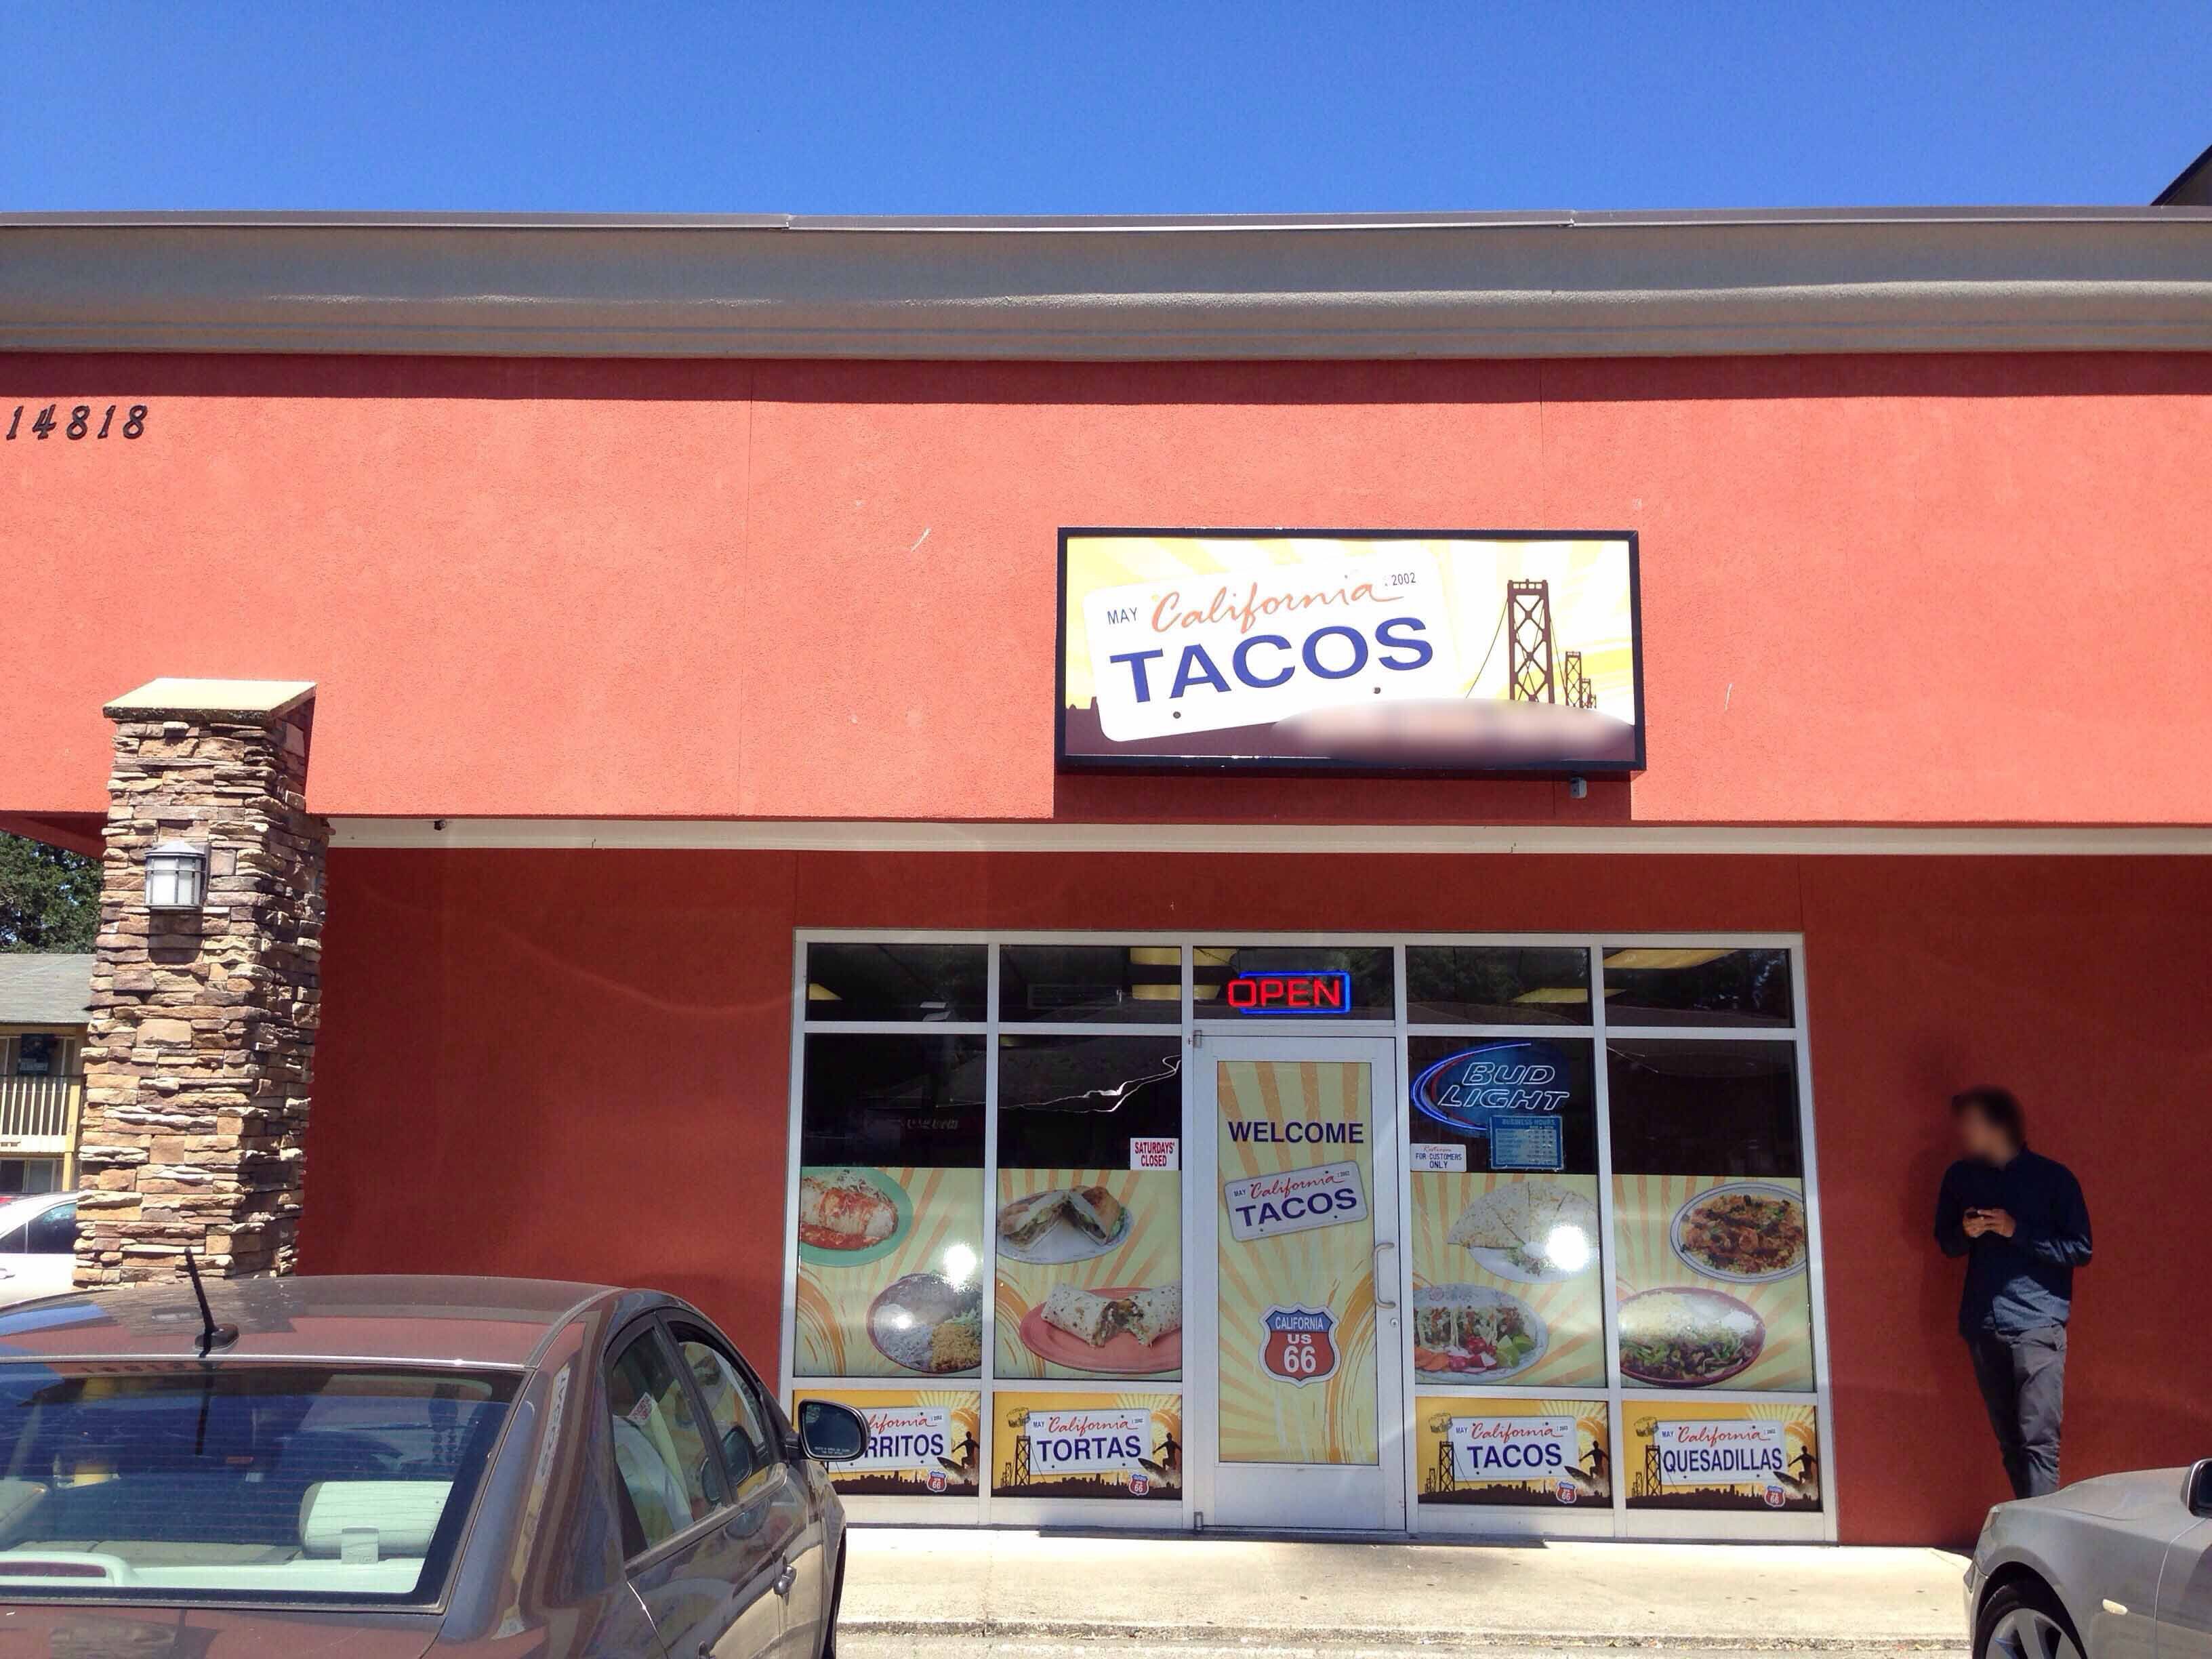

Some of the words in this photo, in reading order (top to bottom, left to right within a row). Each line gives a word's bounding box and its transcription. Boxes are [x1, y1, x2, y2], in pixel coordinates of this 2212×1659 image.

[6, 404, 148, 441] 14818
[1392, 573, 1416, 586] 2002
[1107, 607, 1138, 624] MAY
[1151, 582, 1404, 634] California
[1110, 617, 1433, 703] TACOS
[1228, 979, 1340, 1008] OPEN
[1462, 1062, 1555, 1086] BUD
[1438, 1085, 1570, 1111] LIGHT
[1228, 1122, 1364, 1144] WELCOME
[1141, 1155, 1167, 1167] CLOSED
[1429, 1153, 1462, 1161] CUSTOMERS
[1429, 1160, 1448, 1168] ONLY
[1233, 1189, 1246, 1197] MAY
[1251, 1175, 1345, 1199] California
[1235, 1188, 1357, 1227] TACOS
[1275, 1317, 1324, 1330] CALIFORNIA
[1288, 1334, 1312, 1345] US
[1284, 1346, 1316, 1372] 66
[868, 1414, 937, 1434] lifornia
[1048, 1416, 1139, 1437] California
[1472, 1422, 1563, 1443] California
[864, 1434, 943, 1458] RRITOS
[1036, 1435, 1141, 1462] TORTAS
[1678, 1426, 1771, 1448] California
[1467, 1443, 1562, 1469] TACOS
[1663, 1448, 1782, 1473] QUESADILLAS
